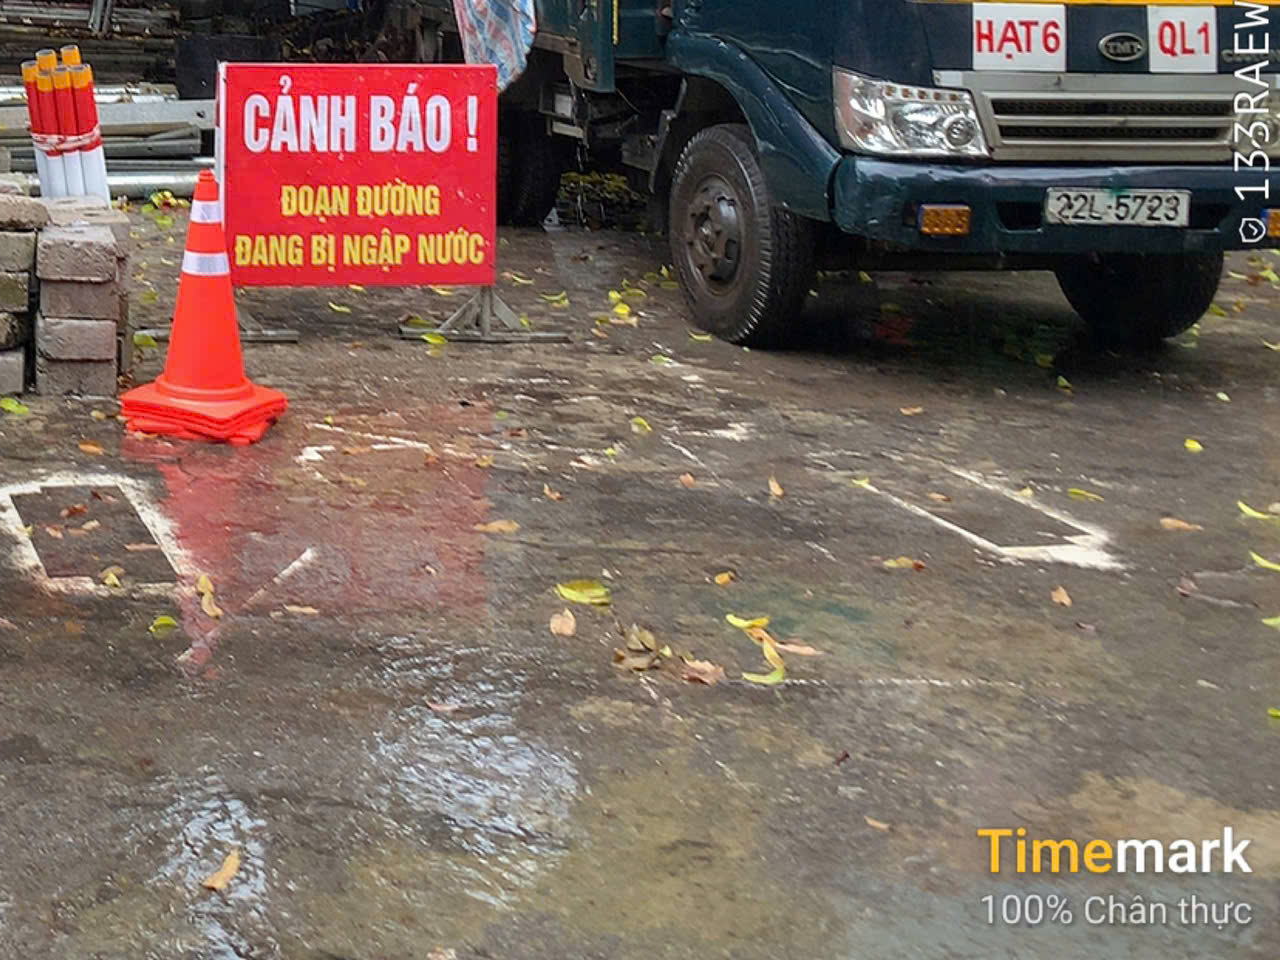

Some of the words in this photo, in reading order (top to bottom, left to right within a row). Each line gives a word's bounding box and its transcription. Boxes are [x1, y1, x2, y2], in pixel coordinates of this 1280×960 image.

[1157, 20, 1210, 56] QL1
[243, 75, 356, 153] CẢNH
[369, 82, 452, 153] BÁO
[281, 185, 350, 223] ĐOẠN
[356, 178, 441, 217] ĐƯỜNG
[234, 234, 304, 266] ĐANG
[310, 234, 336, 273] BỊ
[342, 227, 411, 273] NGẬP
[417, 227, 486, 265] NƯỚC
